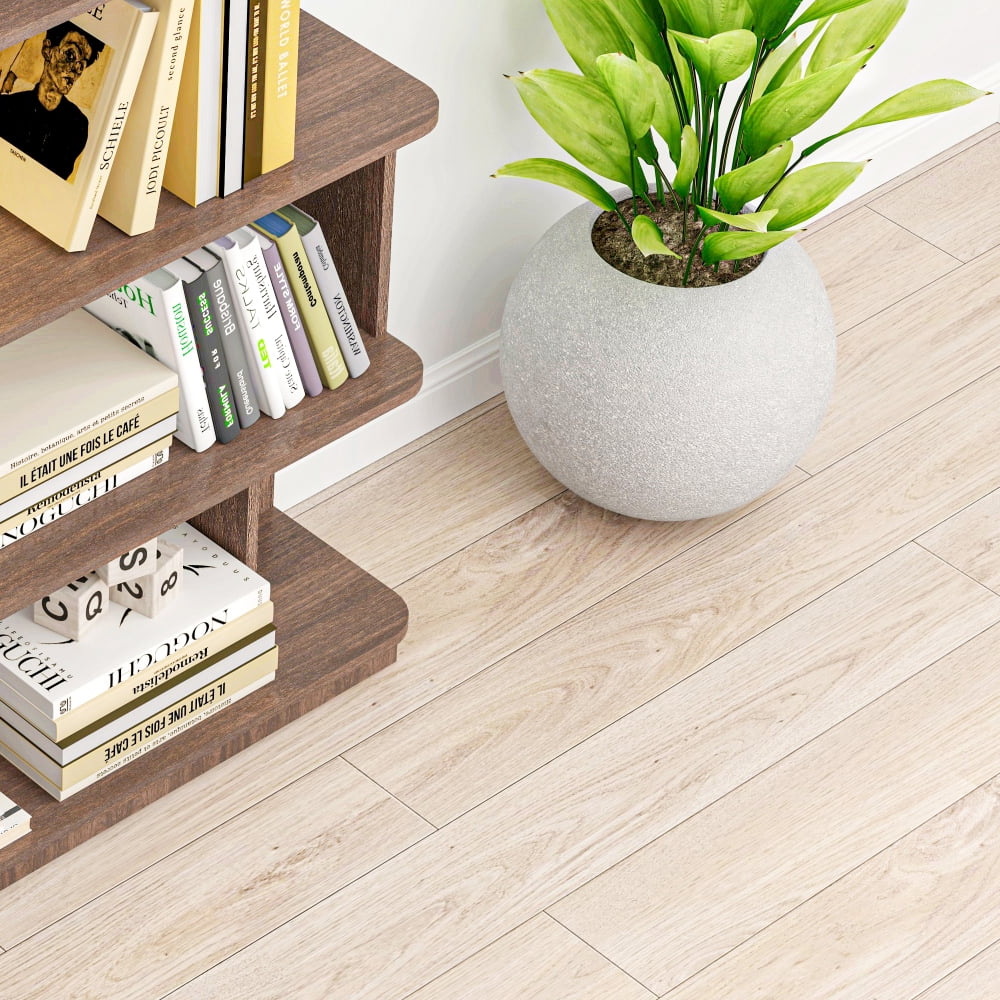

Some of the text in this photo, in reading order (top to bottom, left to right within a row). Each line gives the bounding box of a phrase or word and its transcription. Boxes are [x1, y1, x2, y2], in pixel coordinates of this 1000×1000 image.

[87, 3, 106, 21] E
[167, 7, 186, 81] second glance
[277, 51, 289, 99] BALLET
[99, 101, 130, 170] SCHIELE
[145, 105, 170, 195] JODI PICOULT
[10, 396, 145, 469] Histoire, botanique, arts et petits secrets
[19, 413, 141, 489] IL ÉTAIT UNE FOIS LE CAFÉ
[1, 474, 118, 548] NOGUCHI
[119, 547, 148, 572] S
[160, 570, 178, 597] 8
[41, 595, 69, 622] C
[85, 590, 103, 621] Q
[108, 608, 229, 689] NOGUCHI
[133, 647, 209, 695] Remodelista
[104, 682, 226, 764] IL ÉTAIT UNE FOIS LE CAFÉ
[122, 747, 143, 764] petits
